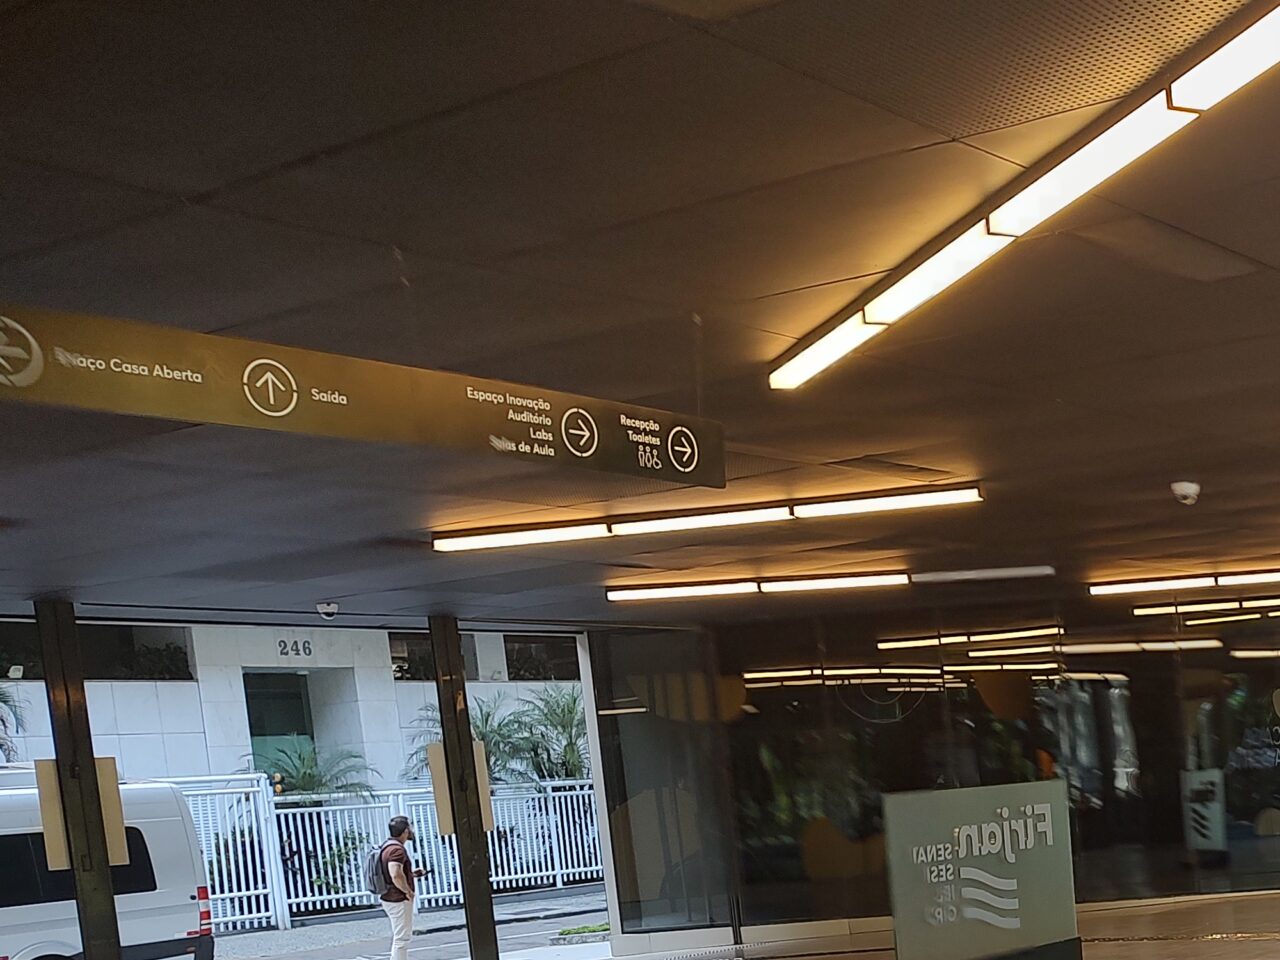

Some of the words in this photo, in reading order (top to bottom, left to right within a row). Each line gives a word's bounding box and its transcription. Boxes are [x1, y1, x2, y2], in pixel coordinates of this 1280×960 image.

[53, 346, 106, 371] aço
[110, 358, 149, 376] Casa
[153, 364, 203, 383] Aberta
[310, 387, 348, 405] Saída
[466, 386, 505, 404] Espaço
[506, 392, 551, 411] Inovação
[507, 409, 552, 426] Auditório
[619, 414, 660, 432] Recepção
[529, 427, 554, 441] Labs
[626, 430, 661, 446] Toaletes
[518, 441, 531, 453] de
[533, 443, 555, 457] Aula
[278, 640, 312, 656] 246
